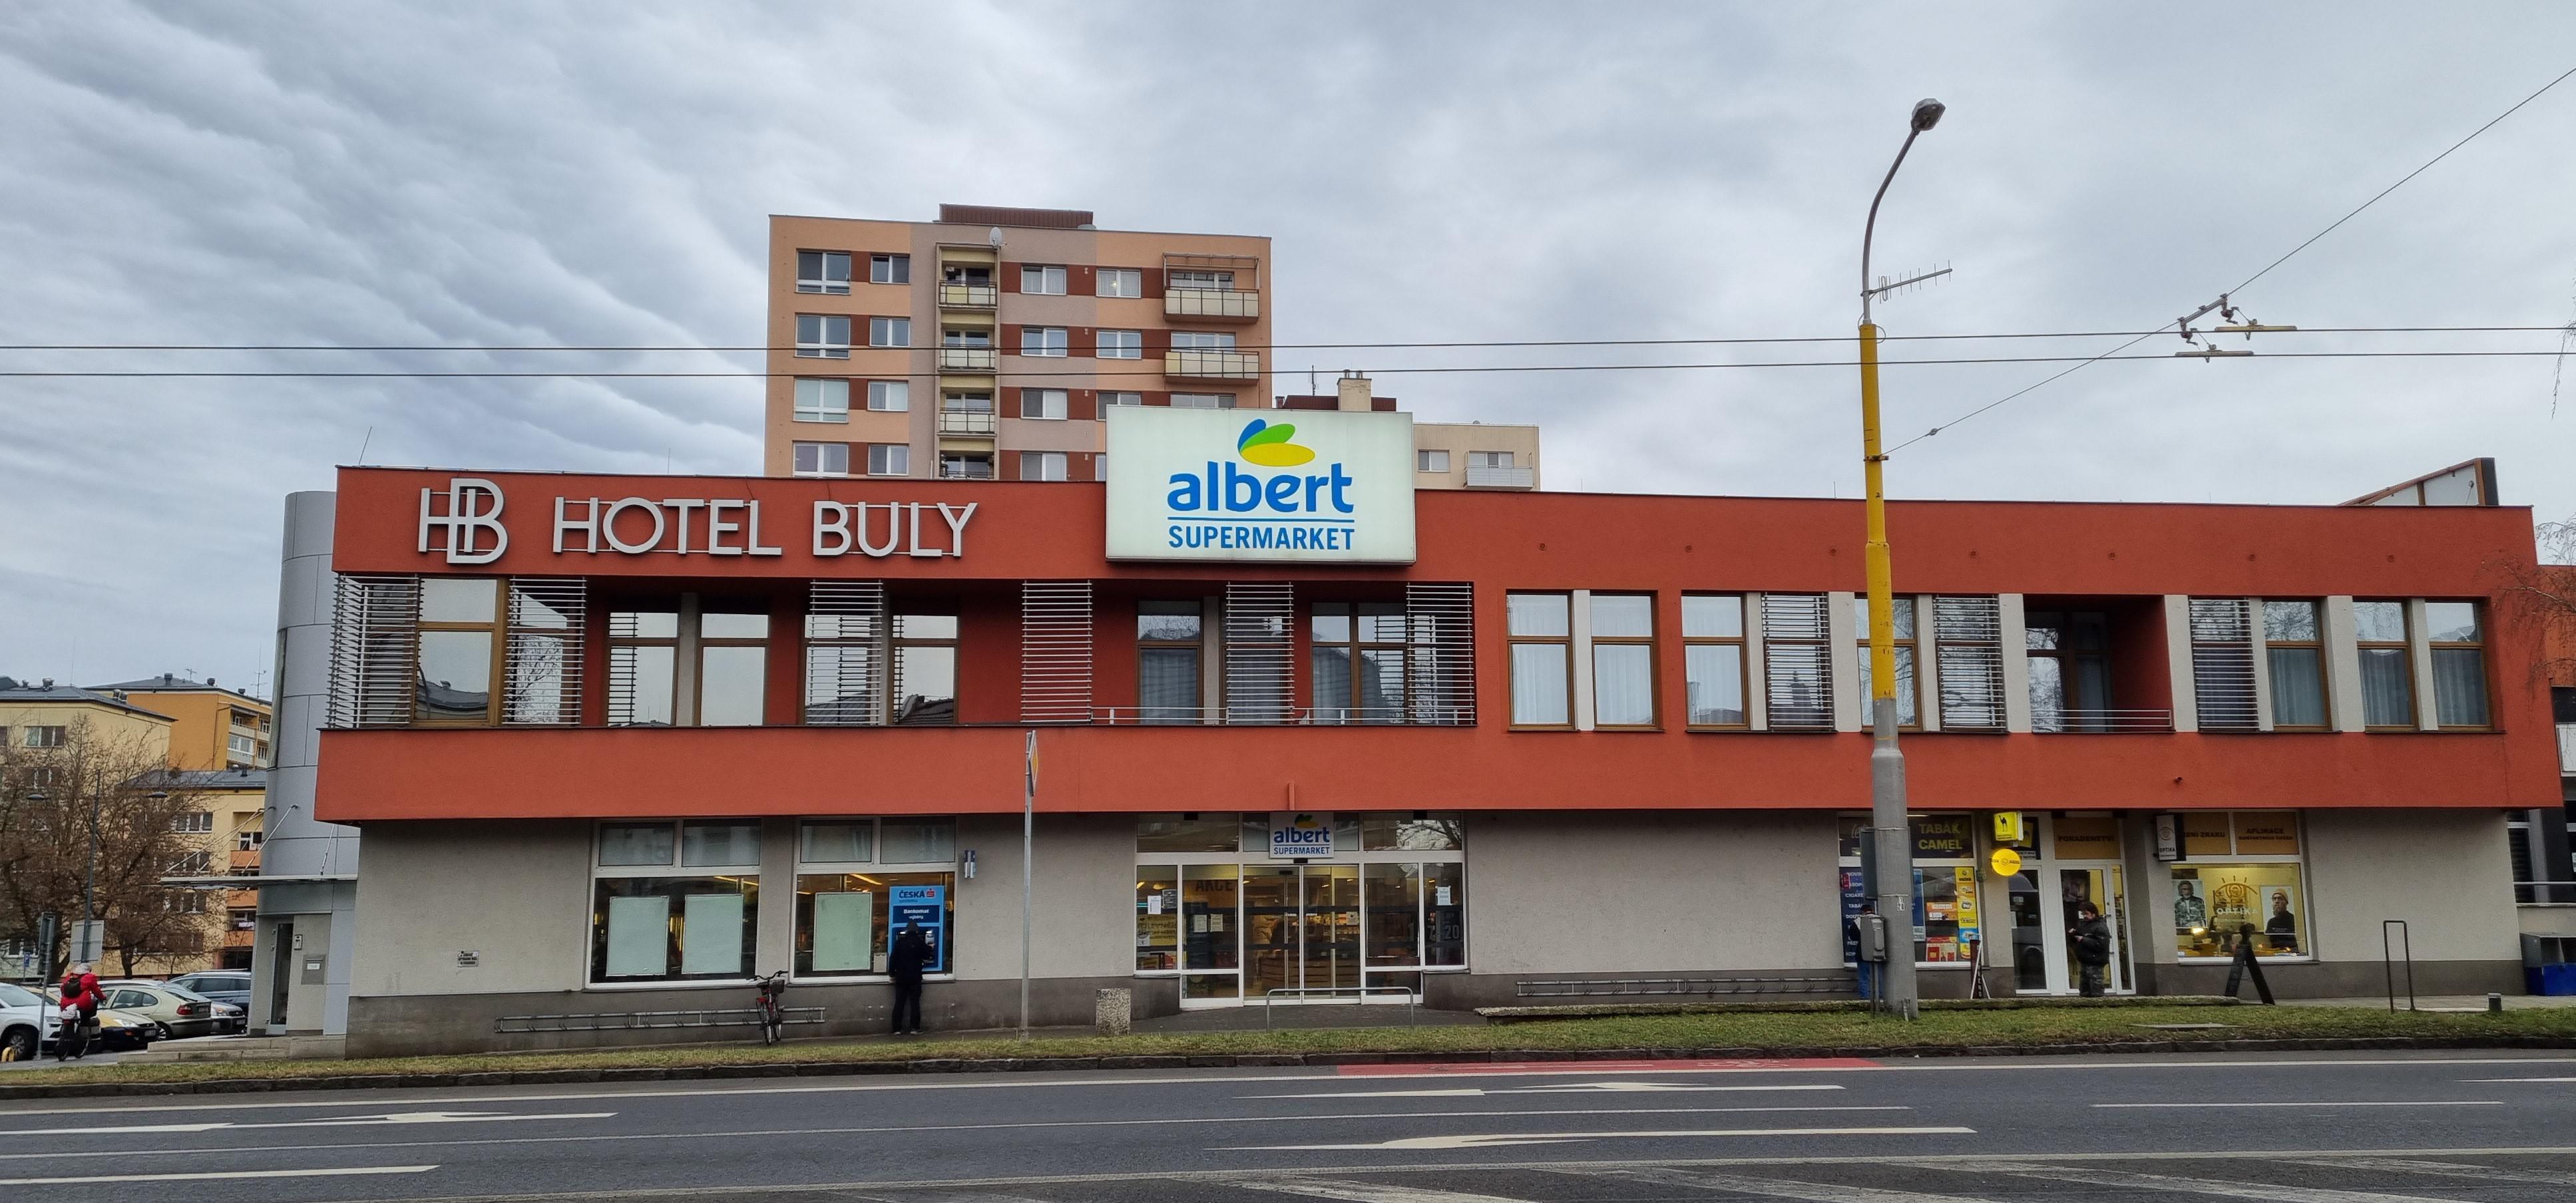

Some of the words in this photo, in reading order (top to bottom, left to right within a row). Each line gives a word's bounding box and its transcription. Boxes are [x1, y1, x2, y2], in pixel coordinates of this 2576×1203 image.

[1167, 460, 1355, 513] albert
[552, 496, 783, 556] HOTEL
[812, 500, 978, 558] BULY
[1168, 525, 1355, 550] SUPERMARKET
[1273, 826, 1330, 843] albert
[1918, 839, 1963, 850] CAMEL
[1273, 846, 1330, 855] SUPERMARKET
